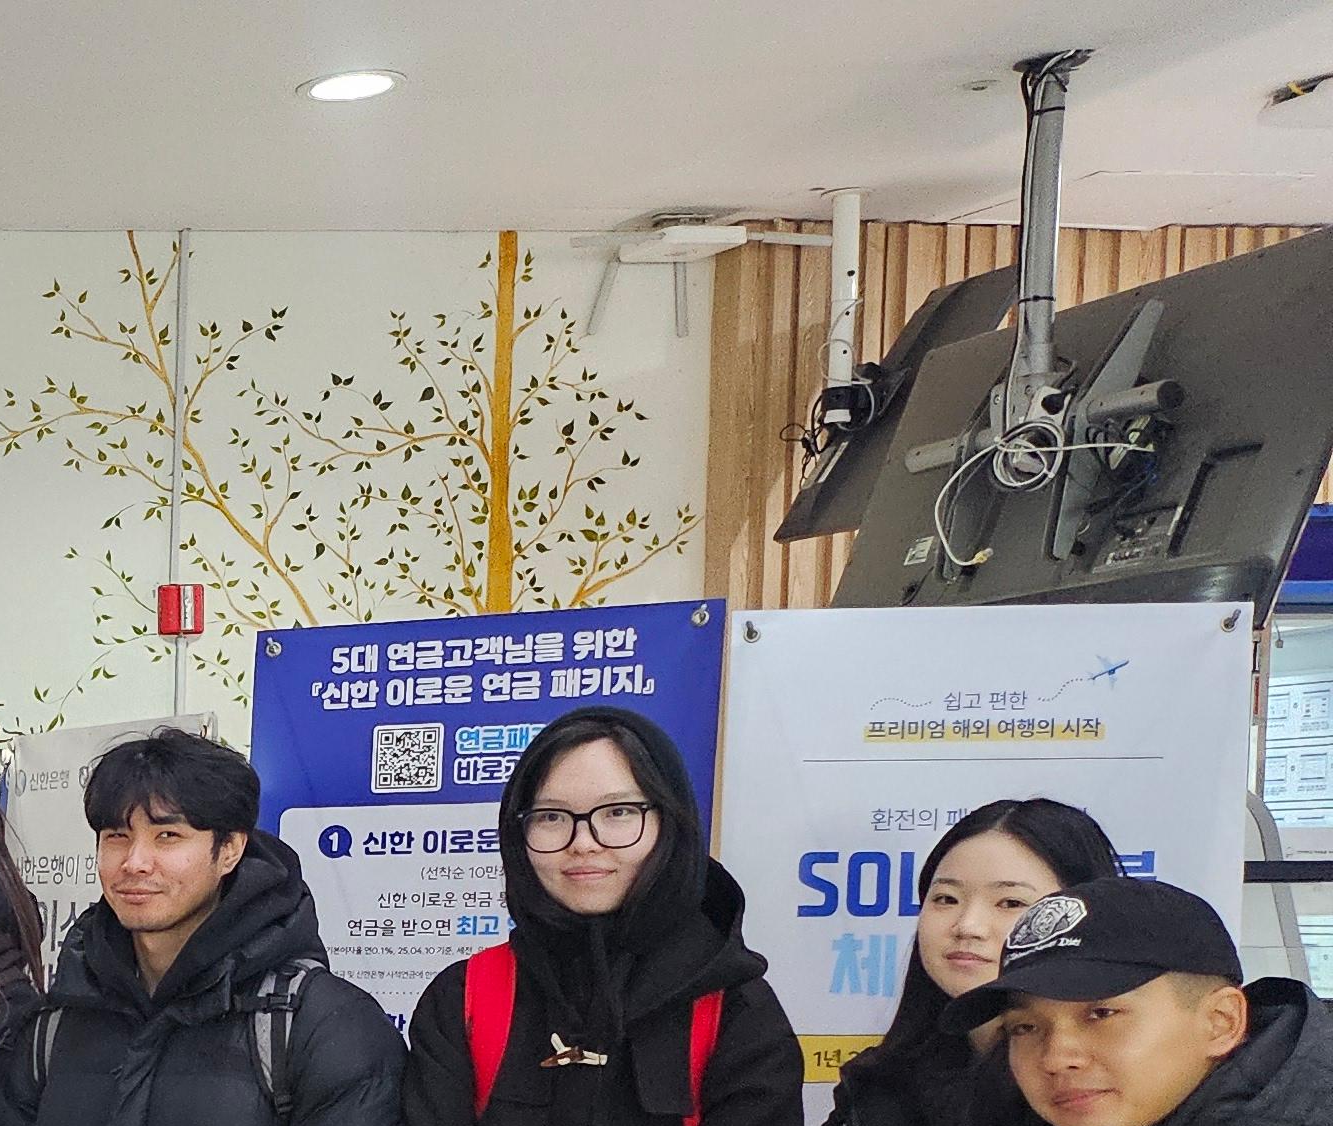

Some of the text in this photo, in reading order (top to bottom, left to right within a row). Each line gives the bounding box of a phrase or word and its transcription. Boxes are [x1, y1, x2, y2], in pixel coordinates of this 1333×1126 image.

[332, 627, 637, 674] 5대 연금고객님을 위한
[386, 675, 473, 707] 이로운
[482, 670, 541, 702] 연금
[944, 690, 1028, 711] 쉽고 편한
[867, 717, 1101, 740] 프리미엄 해외 여행의 시작
[29, 769, 71, 792] 신한은행
[871, 807, 939, 831] 환전의
[363, 831, 414, 856] 신한
[422, 828, 501, 855] 이로운
[17, 855, 81, 886] 한은행이
[797, 851, 921, 918] SOL
[377, 891, 493, 909] 신한 이로운 연금
[347, 915, 500, 937] 연금을 받으면 최고
